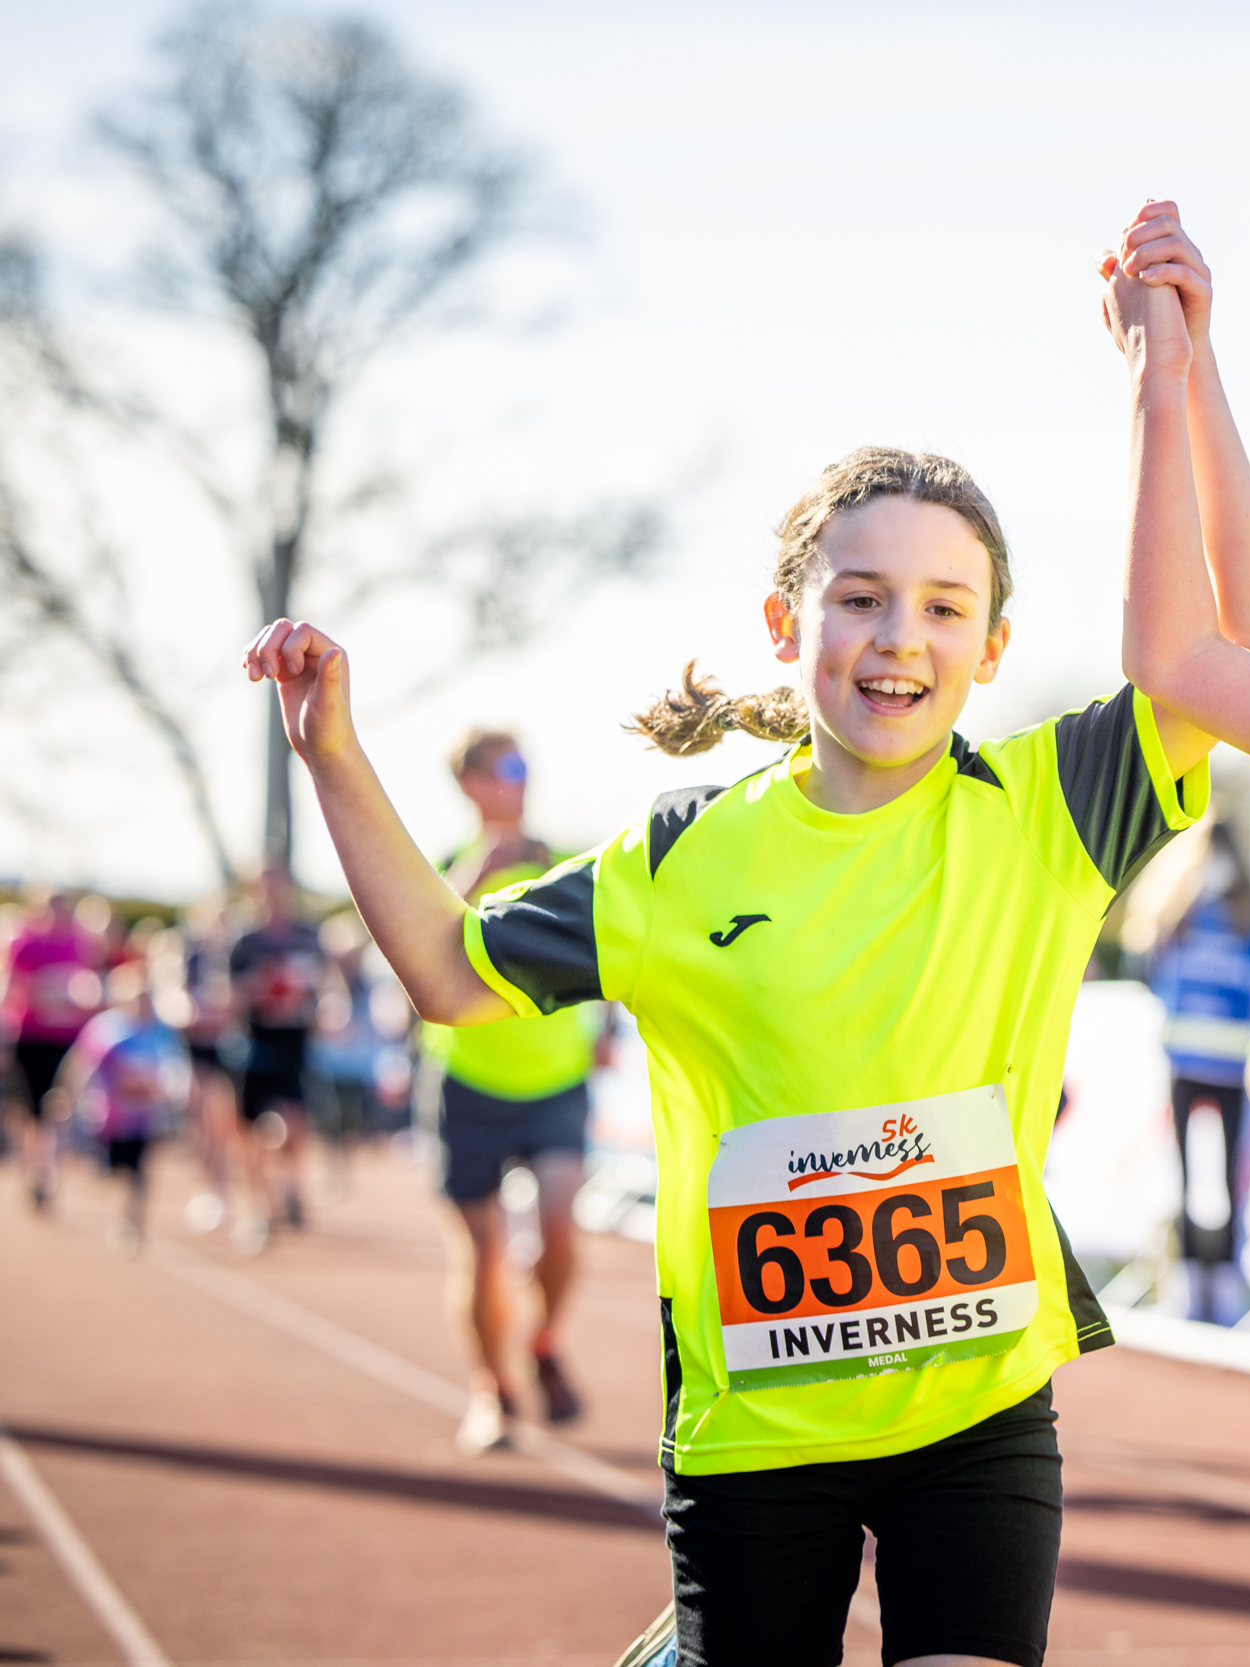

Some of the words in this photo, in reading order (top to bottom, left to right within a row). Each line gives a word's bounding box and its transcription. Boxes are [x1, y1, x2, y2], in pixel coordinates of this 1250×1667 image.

[788, 1132, 932, 1174] inverness
[737, 1180, 1007, 1315] 6365
[769, 1298, 998, 1360] INVERNESS
[868, 1351, 908, 1368] MEDAL
